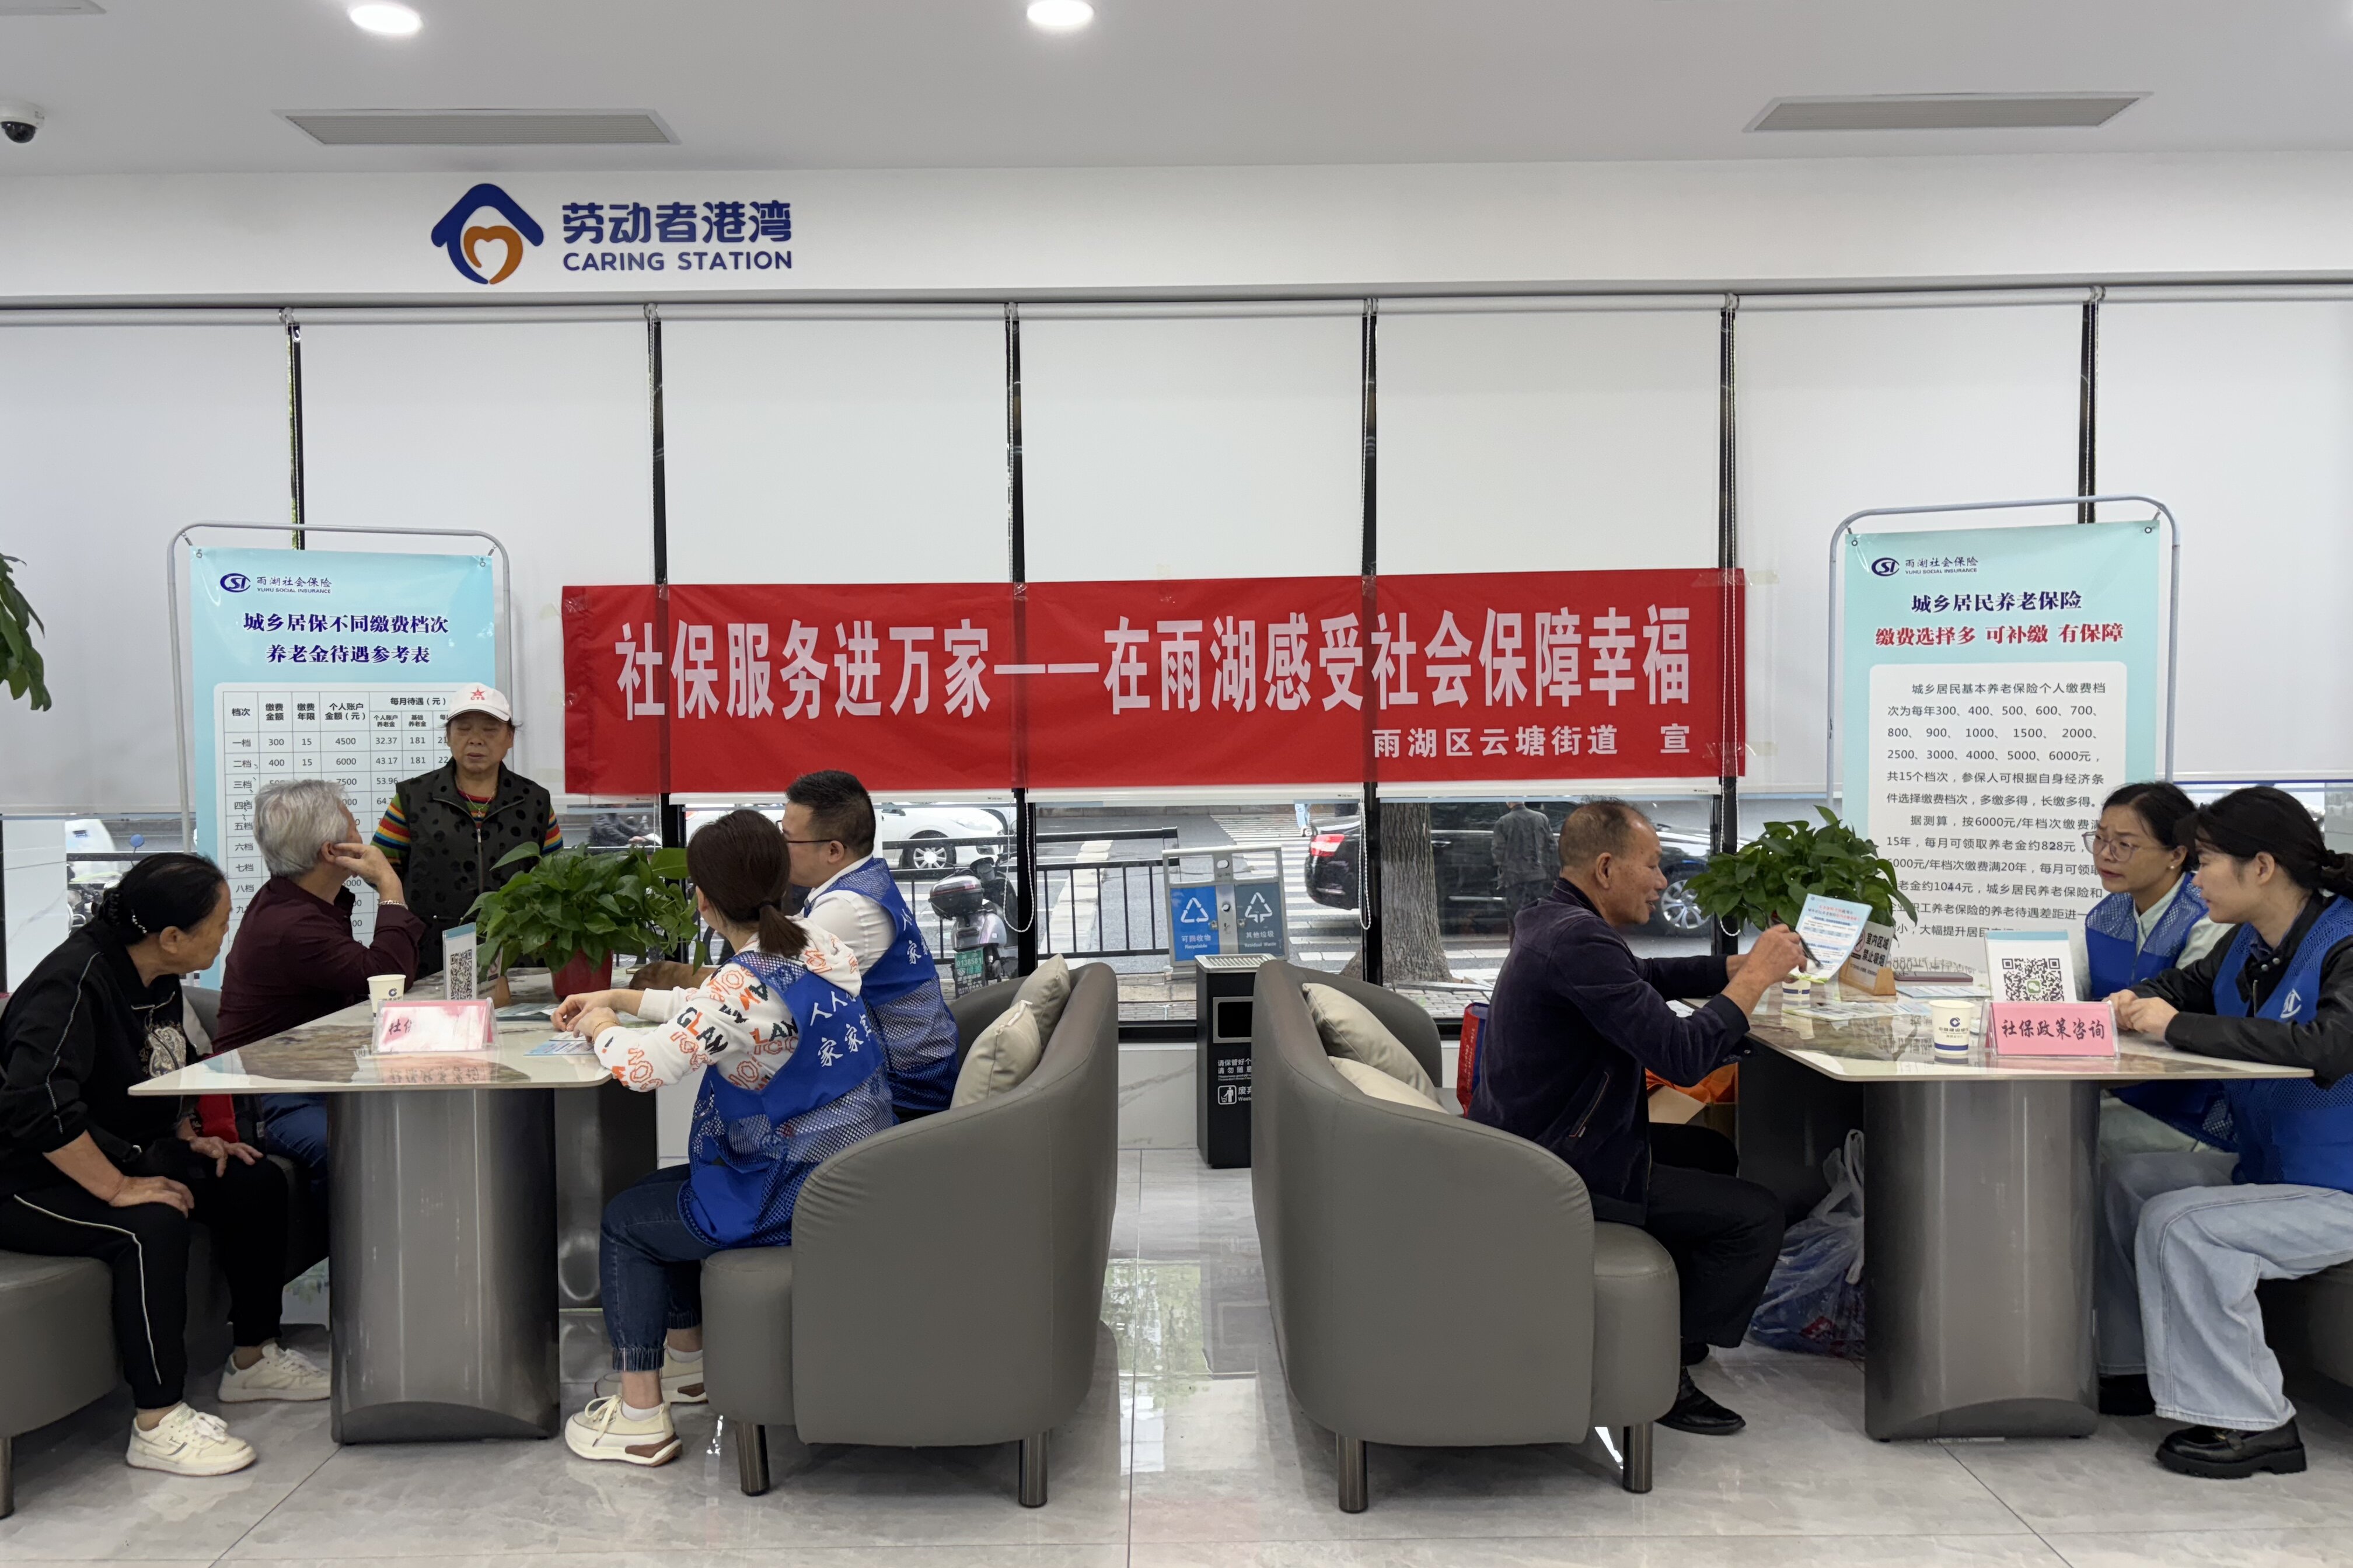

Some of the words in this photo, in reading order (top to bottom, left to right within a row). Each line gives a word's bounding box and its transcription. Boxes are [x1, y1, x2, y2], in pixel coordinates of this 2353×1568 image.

[562, 200, 791, 244] 劳动者港湾
[563, 253, 664, 271] CARING
[678, 251, 791, 270] STATION
[1905, 556, 1978, 568] 雨湖社会保险
[257, 576, 332, 588] 雨湖社会保险
[1912, 591, 2081, 613] 城乡居民养老保险
[243, 613, 448, 633] 城乡居保不同缴费档次
[1876, 626, 1975, 645] 缴费选择多
[1986, 625, 2048, 644] 可补缴
[2059, 623, 2123, 642] 有保障
[267, 644, 430, 663] 养老金待遇参考表
[614, 605, 1691, 721] 社保服务进万家——在雨湖感受社会保障幸福
[1912, 682, 2105, 694] 城乡居民基本养老保险个人缴费档
[265, 703, 284, 711] 缴费
[297, 703, 315, 711] 缴费
[329, 703, 364, 711] 个人账户
[390, 697, 445, 706] 每月待遇（元）
[232, 708, 250, 716] 档次
[266, 712, 284, 721] 金额
[297, 712, 315, 721] 年限
[325, 712, 365, 720] 金额（元）
[232, 739, 251, 747] 一档
[1373, 725, 1617, 757] 雨湖区云塘街道
[1661, 724, 1689, 753] 宣
[437, 755, 449, 764] 22
[1887, 771, 2103, 784] 共15个档次，参保人可根据自身经济条
[233, 780, 252, 788] 三档
[234, 800, 253, 810] 四档
[1887, 793, 2095, 807] 件选择缴费档次，多缴多得，长缴多得。
[235, 822, 253, 831] 五档
[1887, 836, 2084, 853] 15年，每月可领取养老金约828元，
[236, 864, 253, 872] 七档
[1888, 858, 2099, 876] 000元/年档次缴费满20年，每月可领取
[1898, 880, 2103, 899] 老金约1044元，城乡居民养老保险和
[1181, 934, 1212, 943] 可回收物
[1246, 931, 1275, 939] 其他垃圾
[1866, 932, 1889, 950] 室内区域
[2002, 1018, 2104, 1040] 社保政策咨询
